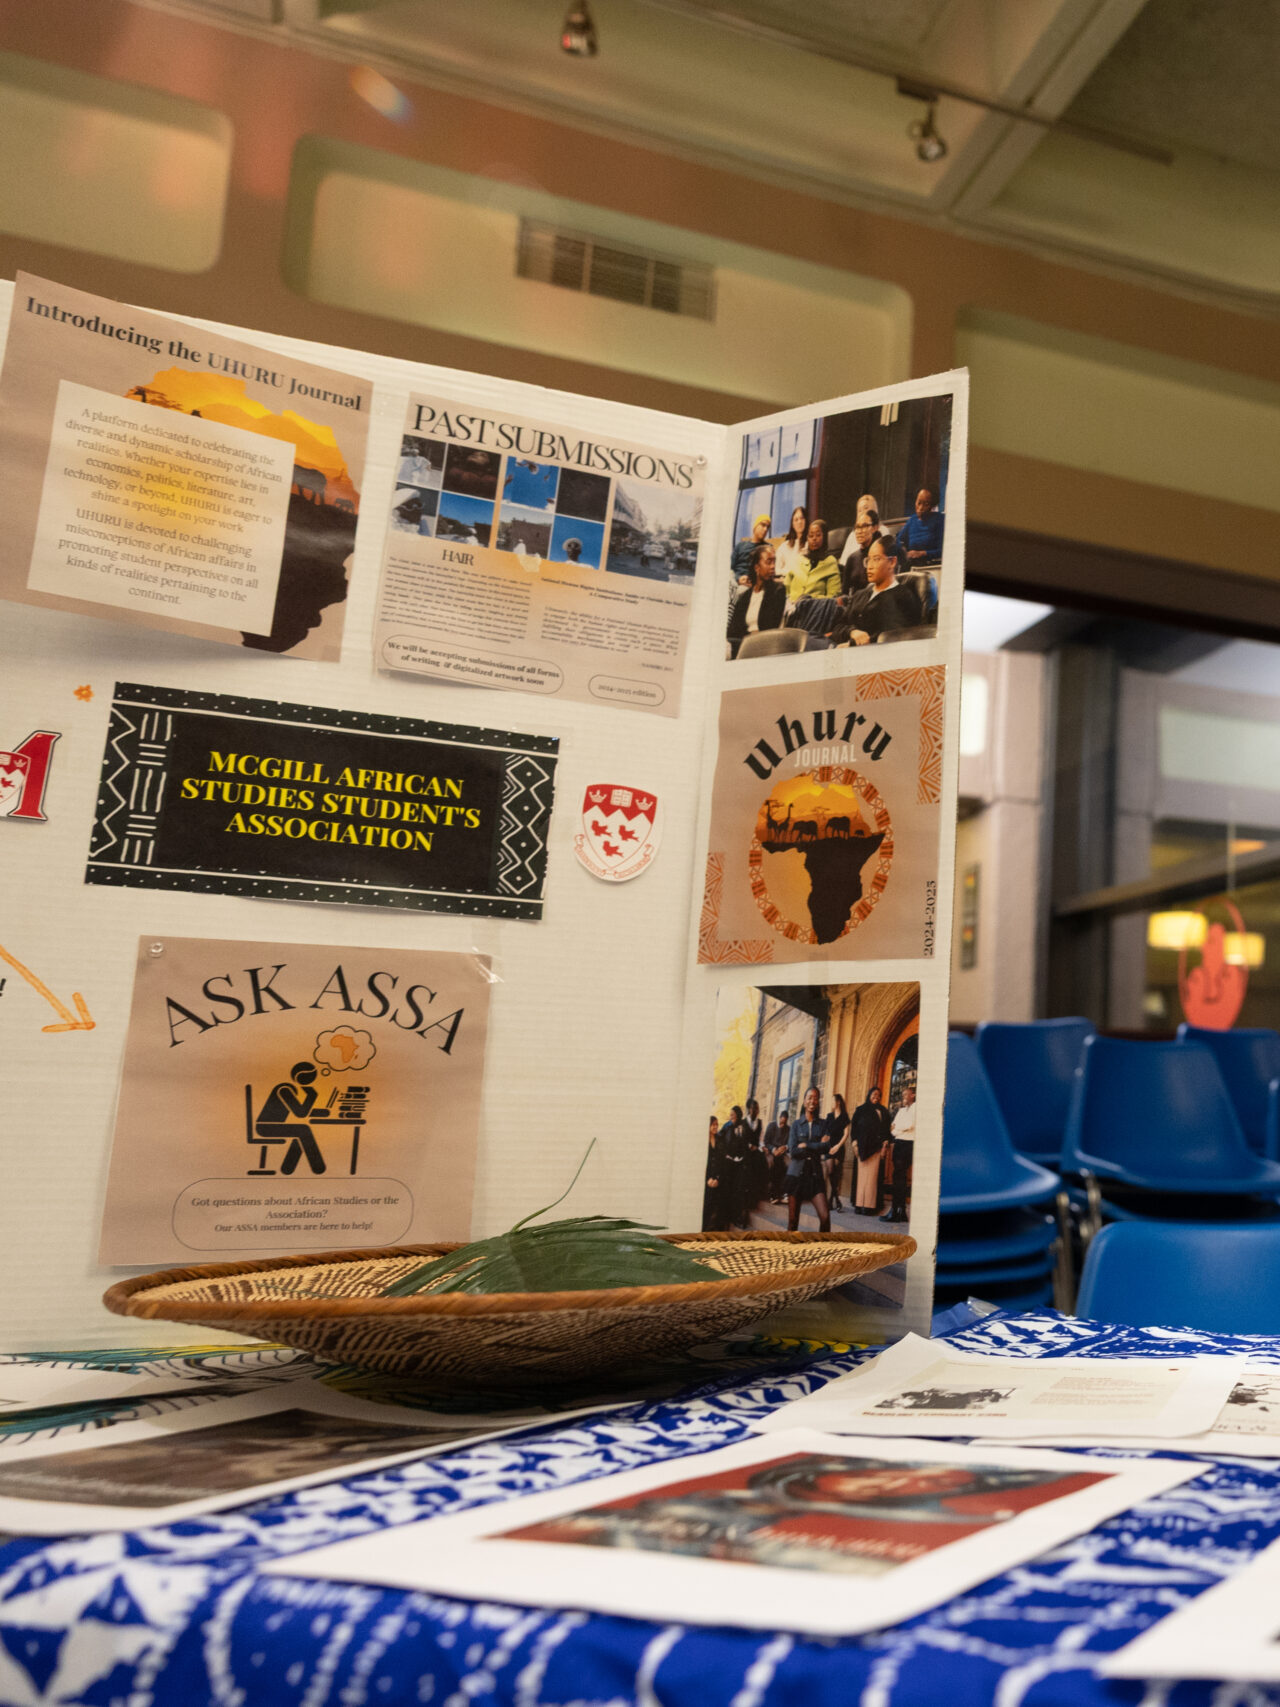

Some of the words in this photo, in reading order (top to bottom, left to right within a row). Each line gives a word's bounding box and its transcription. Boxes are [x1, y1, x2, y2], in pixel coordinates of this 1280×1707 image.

[26, 296, 163, 354] Introducing
[168, 341, 201, 363] the
[207, 352, 284, 387] UHURU
[288, 377, 361, 411] Journal
[65, 418, 105, 437] diverse
[106, 431, 127, 443] and
[128, 435, 174, 455] dynamic
[174, 449, 233, 473] scholarship
[233, 463, 247, 474] of
[245, 466, 282, 483] African
[81, 408, 90, 418] A
[91, 411, 139, 431] platform
[140, 423, 190, 444] dedicated
[190, 437, 201, 447] to
[202, 441, 258, 464] celebrating
[259, 454, 275, 466] the
[412, 404, 494, 444] PAST
[496, 423, 693, 488] SUBMISSIONS
[124, 449, 167, 469] Whether
[168, 462, 192, 475] your
[192, 470, 239, 487] expertise
[90, 489, 121, 504] shine
[121, 498, 130, 506] a
[131, 500, 177, 517] spotlight
[177, 511, 192, 521] on
[193, 514, 217, 526] your
[124, 483, 137, 492] or
[180, 495, 221, 513] UHURU
[232, 509, 261, 522] eager
[261, 515, 273, 525] to
[65, 523, 152, 550] misconceptions
[152, 542, 167, 553] of
[165, 545, 206, 562] African
[208, 554, 245, 570] affairs
[245, 561, 257, 573] in
[75, 507, 122, 527] UHURU
[123, 518, 134, 530] is
[134, 521, 177, 539] devoted
[178, 532, 190, 542] to
[190, 534, 253, 559] challenging
[57, 538, 119, 562] promoting
[119, 552, 162, 568] student
[163, 561, 229, 582] perspectives
[229, 576, 244, 586] on
[244, 578, 259, 589] all
[65, 554, 99, 571] kinds
[99, 563, 114, 574] of
[114, 567, 159, 584] realities
[159, 577, 217, 599] pertaining
[218, 588, 229, 598] to
[229, 590, 247, 602] the
[442, 549, 475, 566] HAIR
[387, 641, 401, 650] We
[401, 644, 418, 652] will
[418, 646, 428, 654] be
[429, 650, 468, 662] accepting
[468, 657, 516, 671] submissions
[536, 667, 560, 678] forms
[411, 656, 440, 667] writing
[452, 663, 493, 677] digitalized
[493, 672, 524, 682] artwork
[526, 677, 544, 685] soon
[743, 709, 892, 780] uhuru
[794, 744, 857, 767] JOURNAL
[208, 751, 330, 784] MCGILL
[335, 767, 464, 799] AFRICAN
[180, 777, 315, 811] STUDIES
[321, 792, 481, 829] STUDENT'S
[225, 812, 434, 851] ASSOCIATION
[923, 880, 936, 956] 2024-2025
[166, 964, 296, 1048] ASK
[309, 964, 465, 1055] ASSA
[191, 1197, 210, 1207] Got
[212, 1197, 263, 1208] questions
[264, 1197, 292, 1206] about
[296, 1196, 331, 1206] African
[334, 1196, 369, 1205] Studies
[370, 1197, 381, 1205] or
[383, 1196, 399, 1205] the
[265, 1209, 328, 1219] Association?
[214, 1223, 232, 1232] Our
[234, 1223, 258, 1232] ASSA
[260, 1223, 300, 1231] members
[303, 1223, 318, 1231] are
[319, 1222, 338, 1231] here
[341, 1222, 350, 1230] to
[352, 1221, 373, 1232] help!
